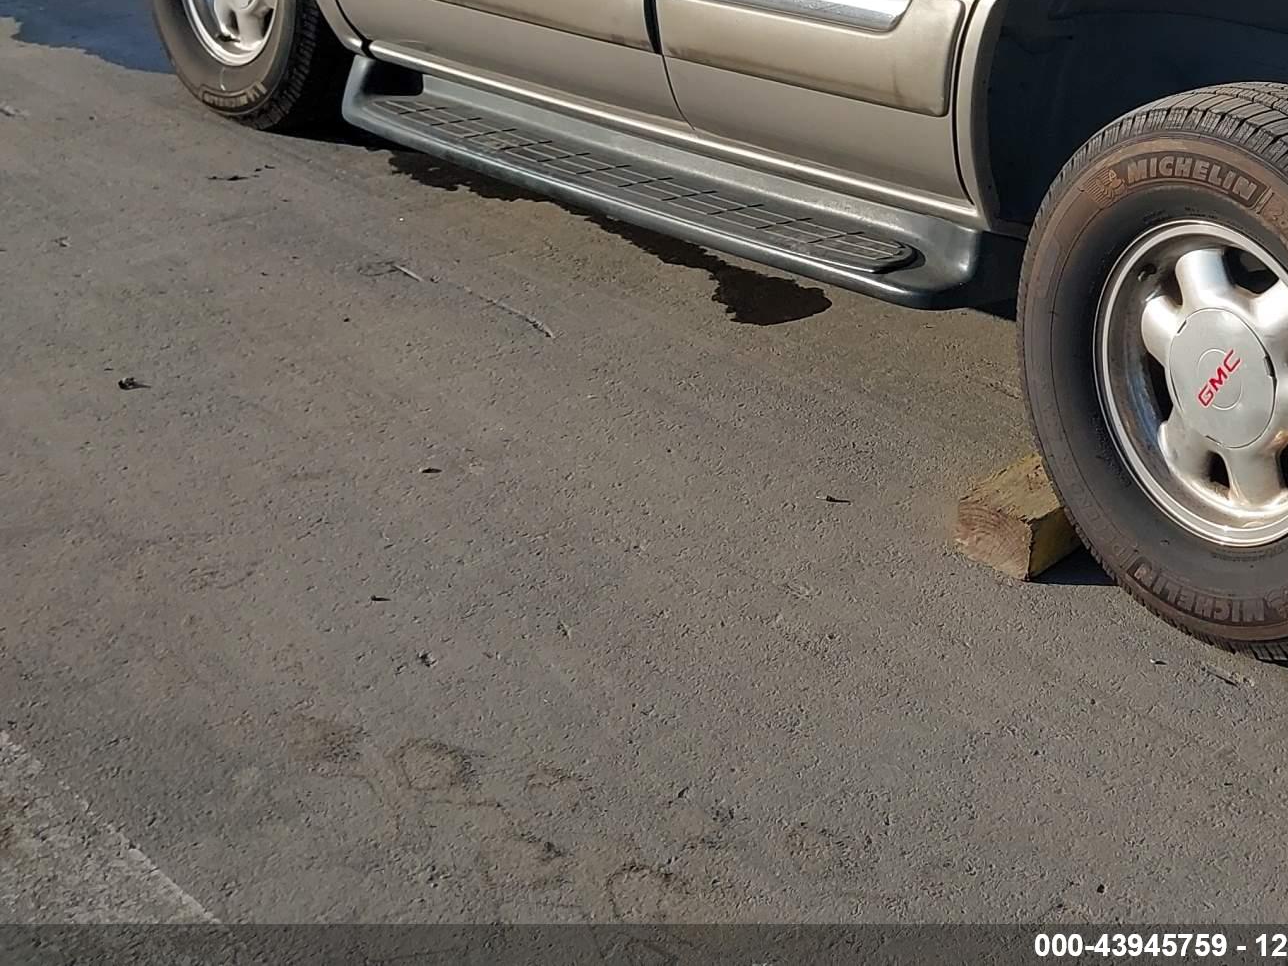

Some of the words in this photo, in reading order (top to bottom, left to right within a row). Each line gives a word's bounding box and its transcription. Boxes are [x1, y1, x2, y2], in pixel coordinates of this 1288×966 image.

[1127, 156, 1258, 201] MICHELIN
[1198, 348, 1241, 408] GMC
[1134, 562, 1265, 622] MICHELIN
